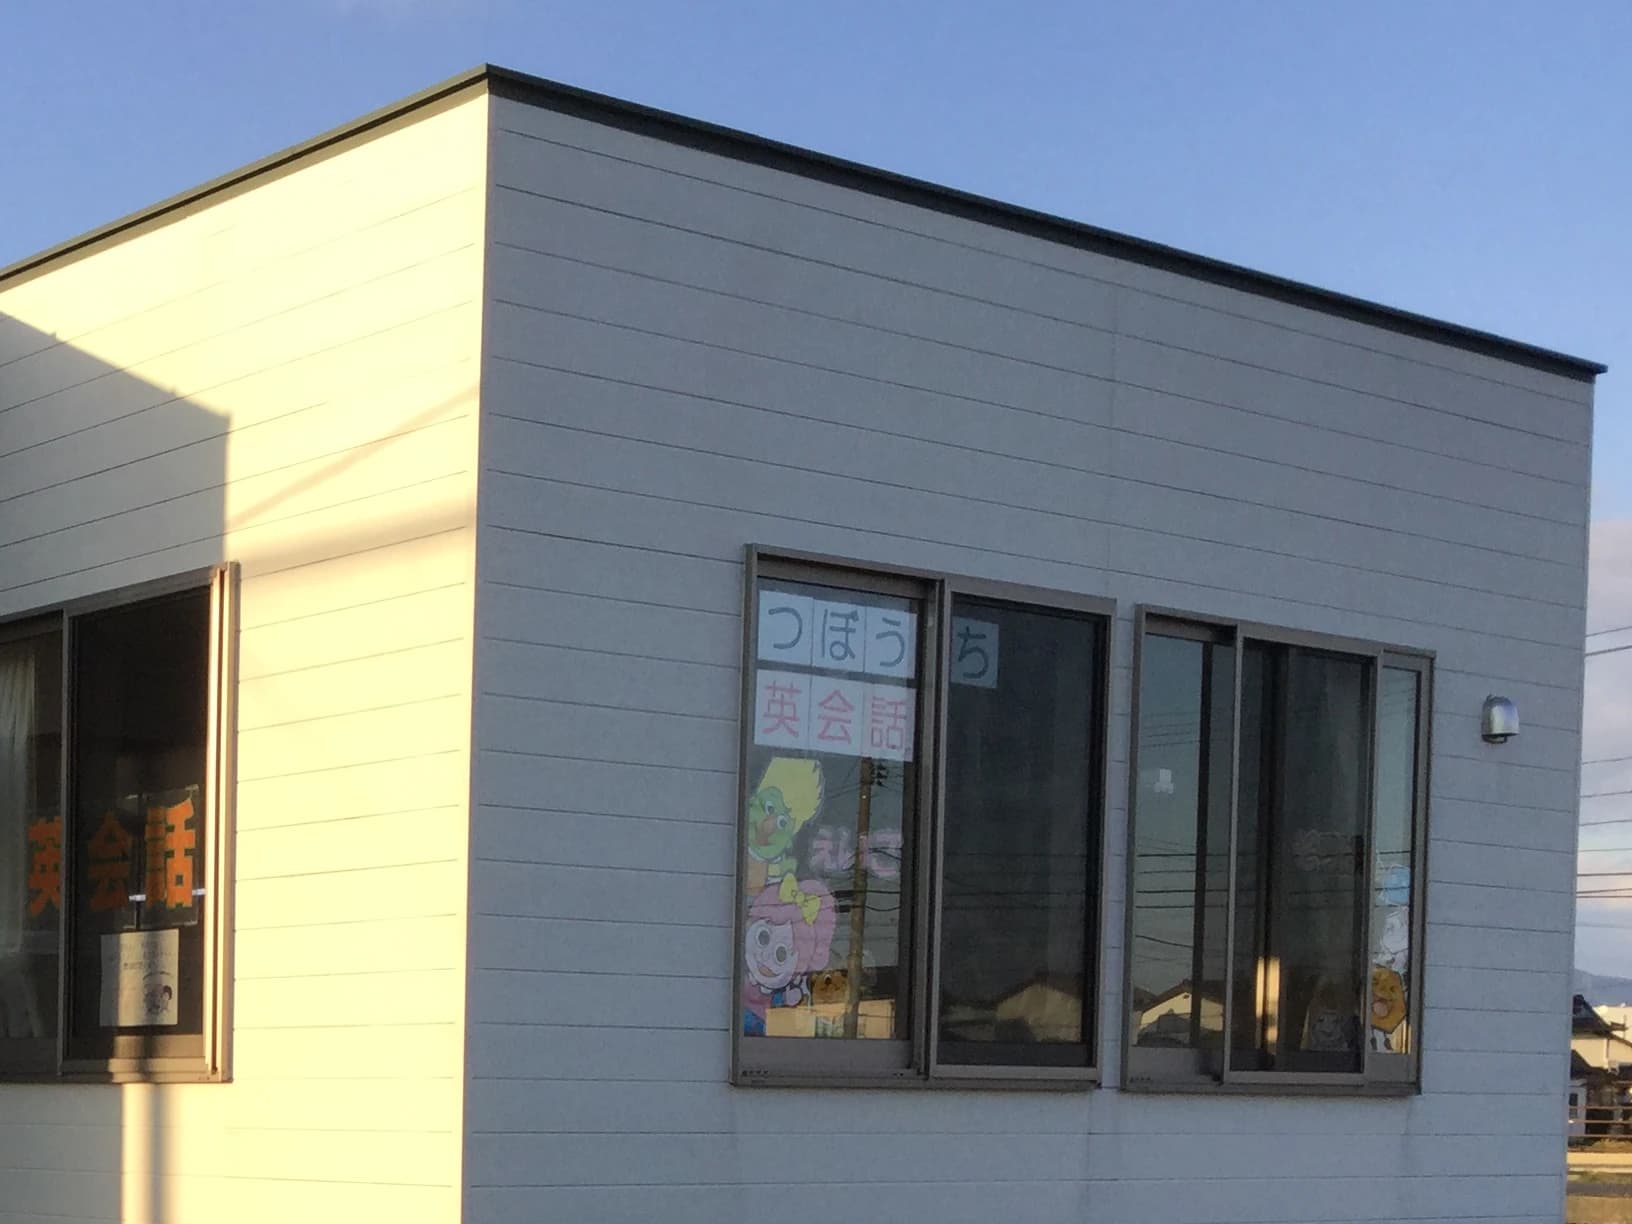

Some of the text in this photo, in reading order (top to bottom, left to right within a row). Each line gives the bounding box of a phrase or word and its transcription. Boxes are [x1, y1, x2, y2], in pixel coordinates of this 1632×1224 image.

[768, 605, 990, 680] つぼうち
[762, 680, 908, 749] 英会話
[27, 797, 196, 918] 英会話
